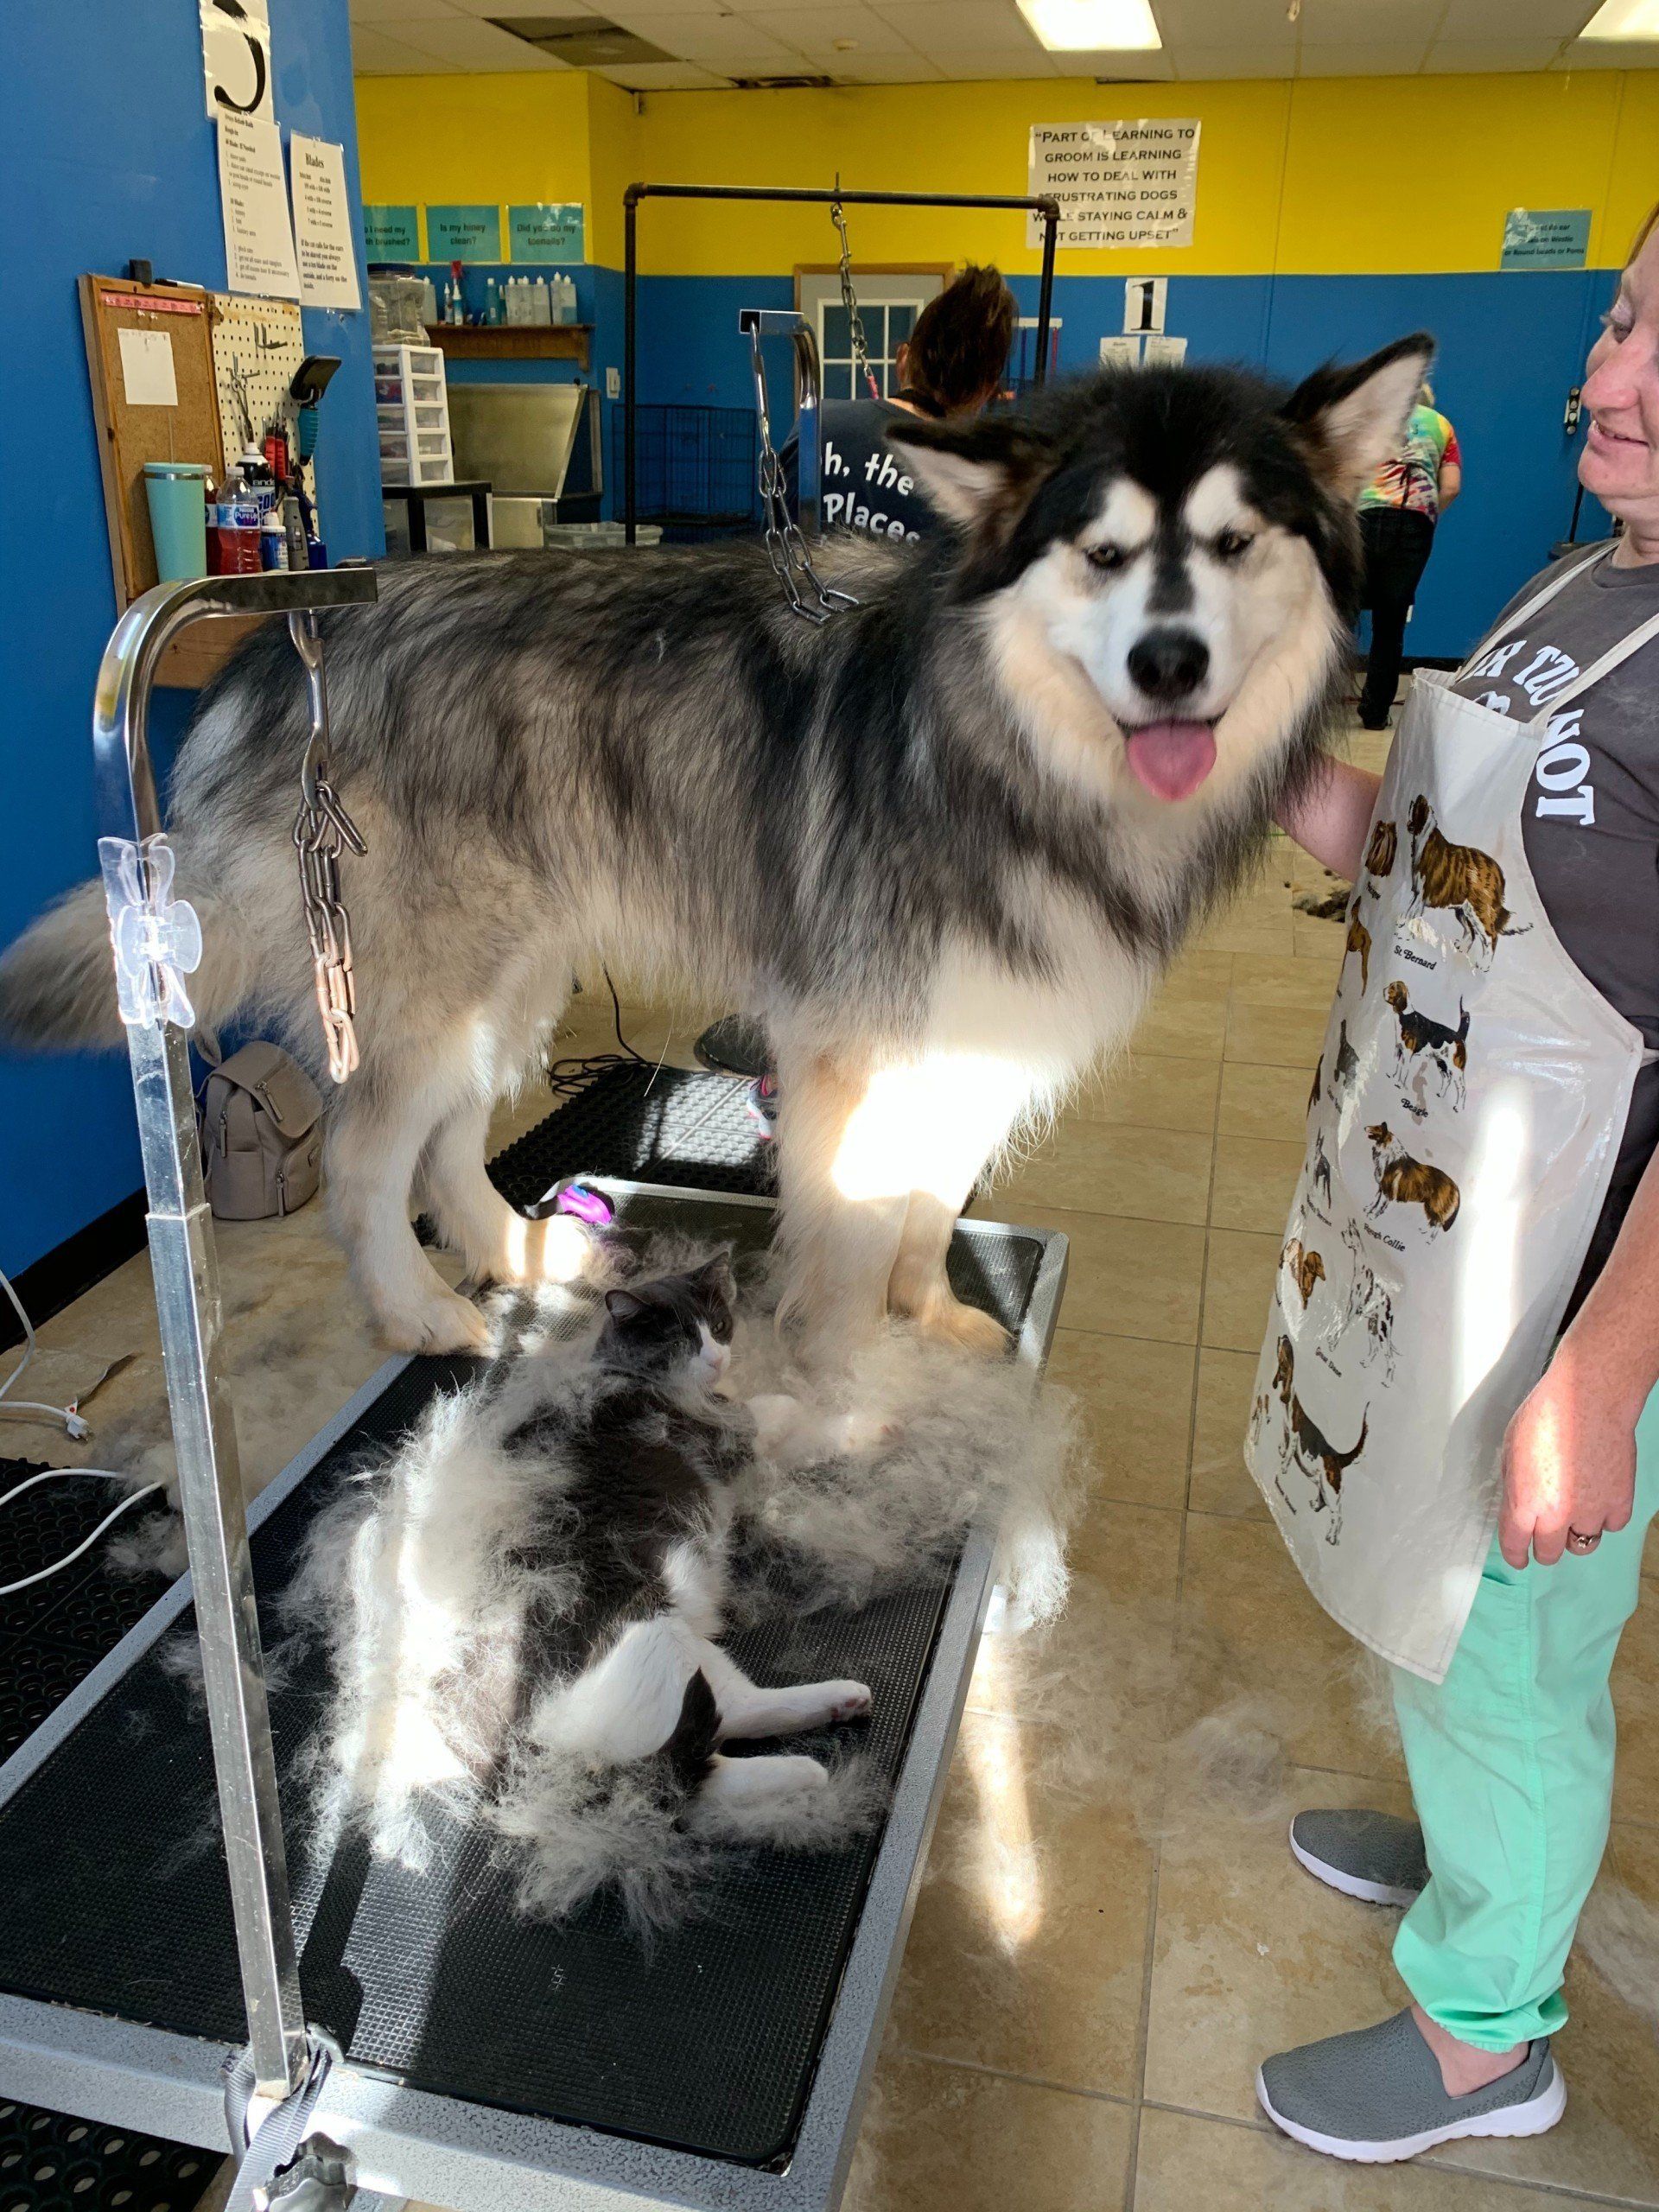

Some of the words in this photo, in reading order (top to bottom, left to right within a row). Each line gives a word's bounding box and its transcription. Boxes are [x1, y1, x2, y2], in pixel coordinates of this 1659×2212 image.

[1178, 128, 1195, 139] TO
[305, 153, 325, 168] Blades
[1045, 152, 1093, 162] GROOM
[1097, 152, 1109, 161] IS
[1112, 149, 1182, 161] LEARNING
[1047, 172, 1079, 182] HOW
[1082, 172, 1100, 182] TO
[1103, 171, 1139, 181] DEAL
[1142, 170, 1177, 180] WITH
[1140, 190, 1178, 200] DOGS
[1077, 210, 1132, 221] STAYING
[1136, 210, 1174, 220] CALM
[1177, 208, 1188, 219] &
[440, 223, 447, 232] Is
[450, 225, 461, 234] my
[517, 223, 531, 232] Did
[564, 225, 576, 234] my
[450, 236, 477, 245] clean?
[1039, 232, 1066, 241] NT
[1069, 230, 1125, 241] GETTING
[1130, 280, 1161, 331] 1
[821, 441, 851, 477] h,
[864, 453, 914, 496] the
[1403, 949, 1437, 970] Bernard
[1401, 1098, 1428, 1118] Beagle
[1383, 1235, 1405, 1252] Collie
